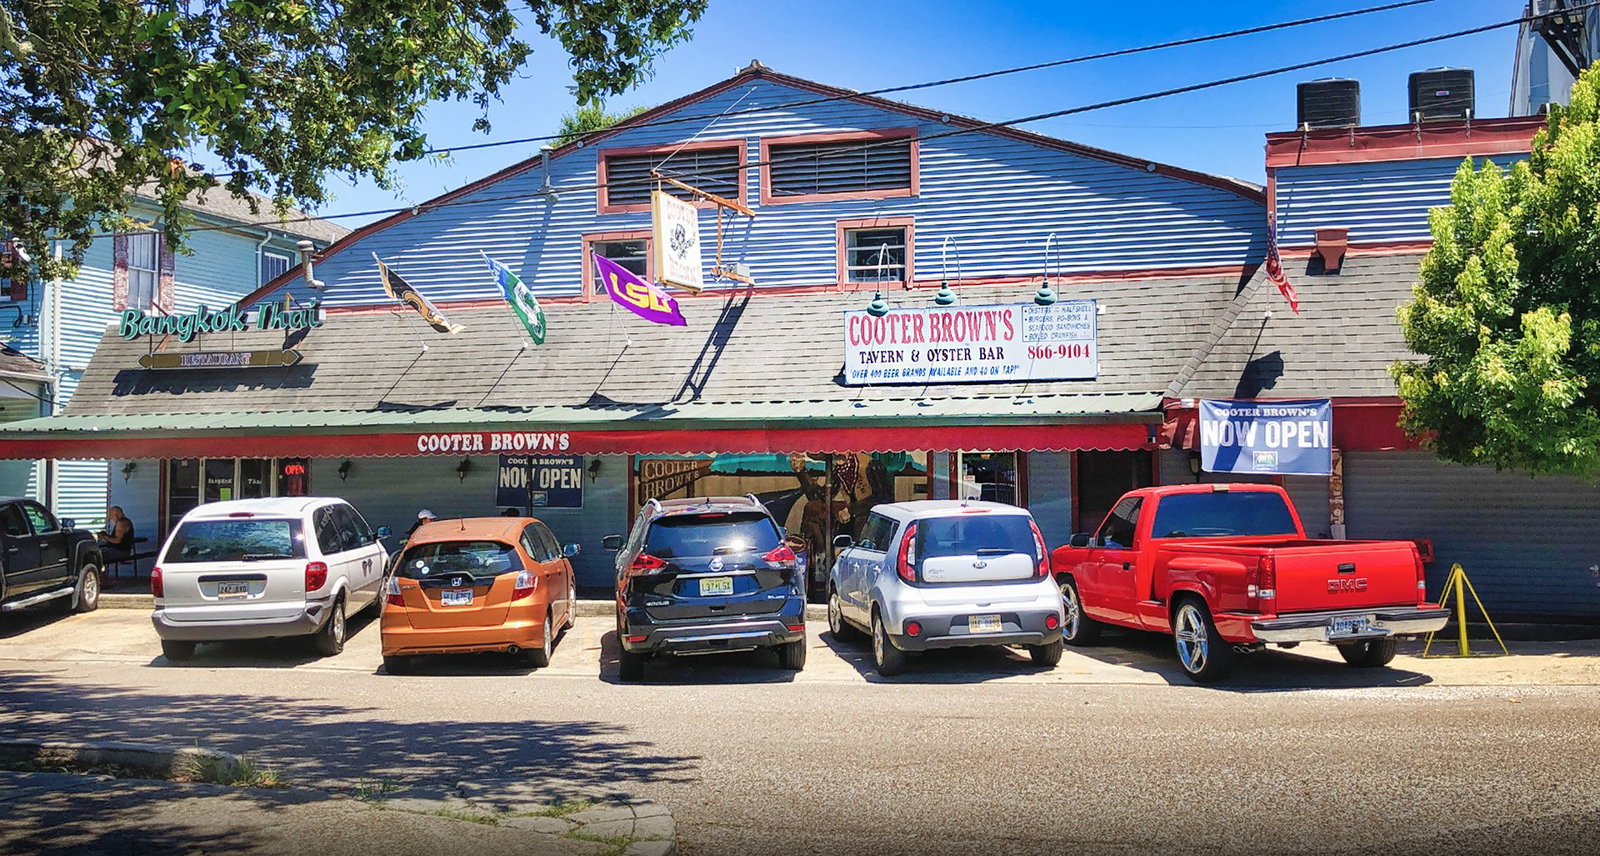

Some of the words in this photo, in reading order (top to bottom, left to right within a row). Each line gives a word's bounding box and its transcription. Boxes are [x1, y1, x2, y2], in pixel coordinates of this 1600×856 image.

[610, 272, 672, 313] LSU
[119, 303, 246, 342] Bangkok
[255, 300, 320, 329] Thai
[849, 313, 925, 346] COOTER
[928, 309, 1014, 343] BROWN'S
[180, 352, 252, 366] RESTAURANT
[859, 350, 904, 364] TAVERN
[911, 349, 920, 362] &
[927, 348, 972, 362] OYSTER
[979, 346, 1004, 360] BAR
[1027, 344, 1090, 359] 866-9104
[884, 368, 899, 378] BEER
[902, 367, 926, 377] BRANDS
[929, 366, 961, 377] AVAILABLE
[965, 366, 977, 376] AND
[979, 366, 988, 376] 40
[990, 366, 999, 376] ON
[1214, 407, 1261, 417] COOTER
[1263, 407, 1318, 417] BROWN'S
[417, 434, 483, 451] COOTER
[490, 433, 570, 450] BROWN'S
[1202, 420, 1258, 447] NOW
[1265, 420, 1329, 448] OPEN
[284, 464, 305, 475] OPEN
[540, 468, 581, 489] OPEN
[645, 461, 698, 480] COOTER
[1327, 577, 1368, 591] GMC
